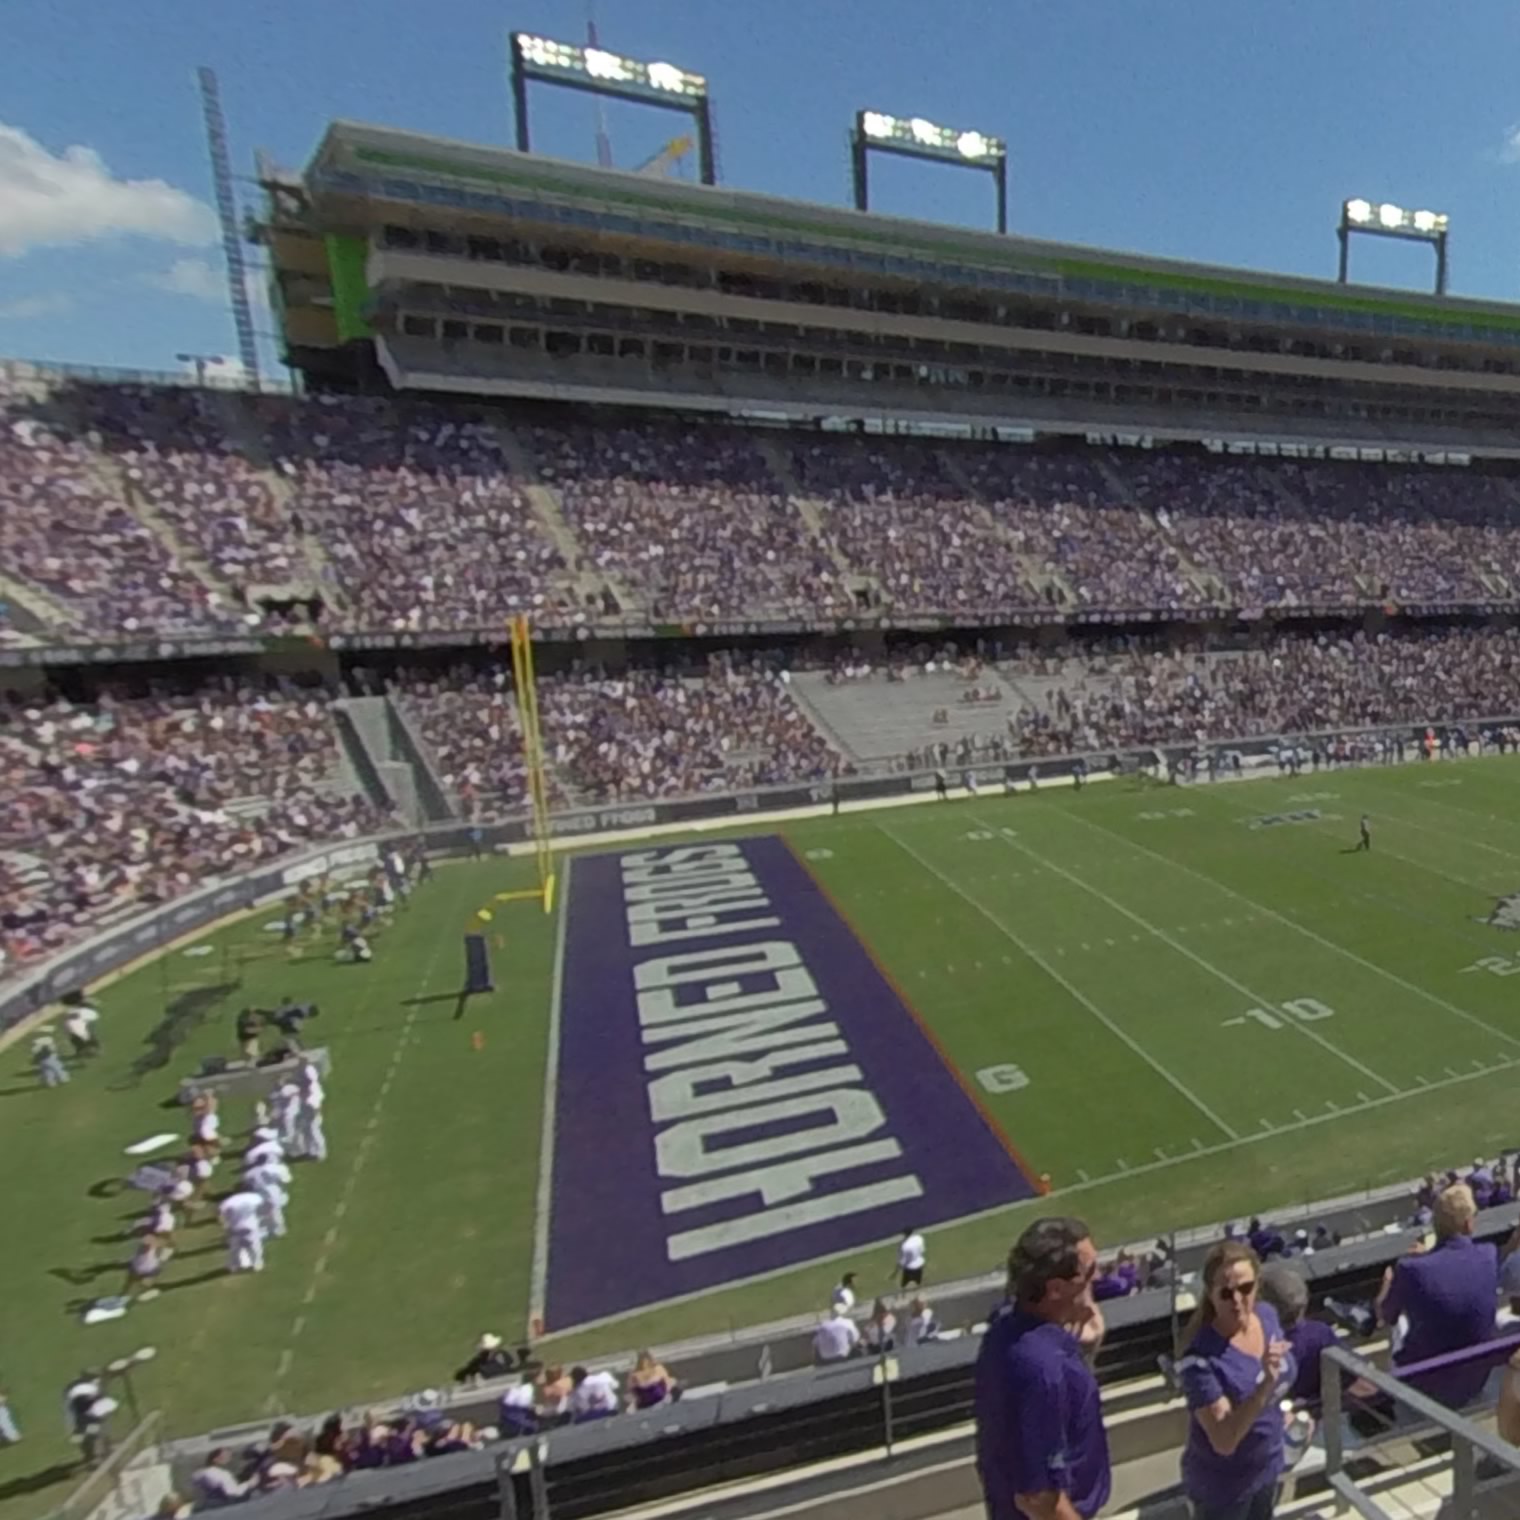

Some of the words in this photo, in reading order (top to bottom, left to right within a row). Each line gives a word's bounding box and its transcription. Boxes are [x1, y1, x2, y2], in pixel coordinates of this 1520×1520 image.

[620, 844, 783, 947] FROGS
[1246, 997, 1335, 1030] 10
[633, 940, 924, 1263] HORNED
[975, 1062, 1031, 1094] G
